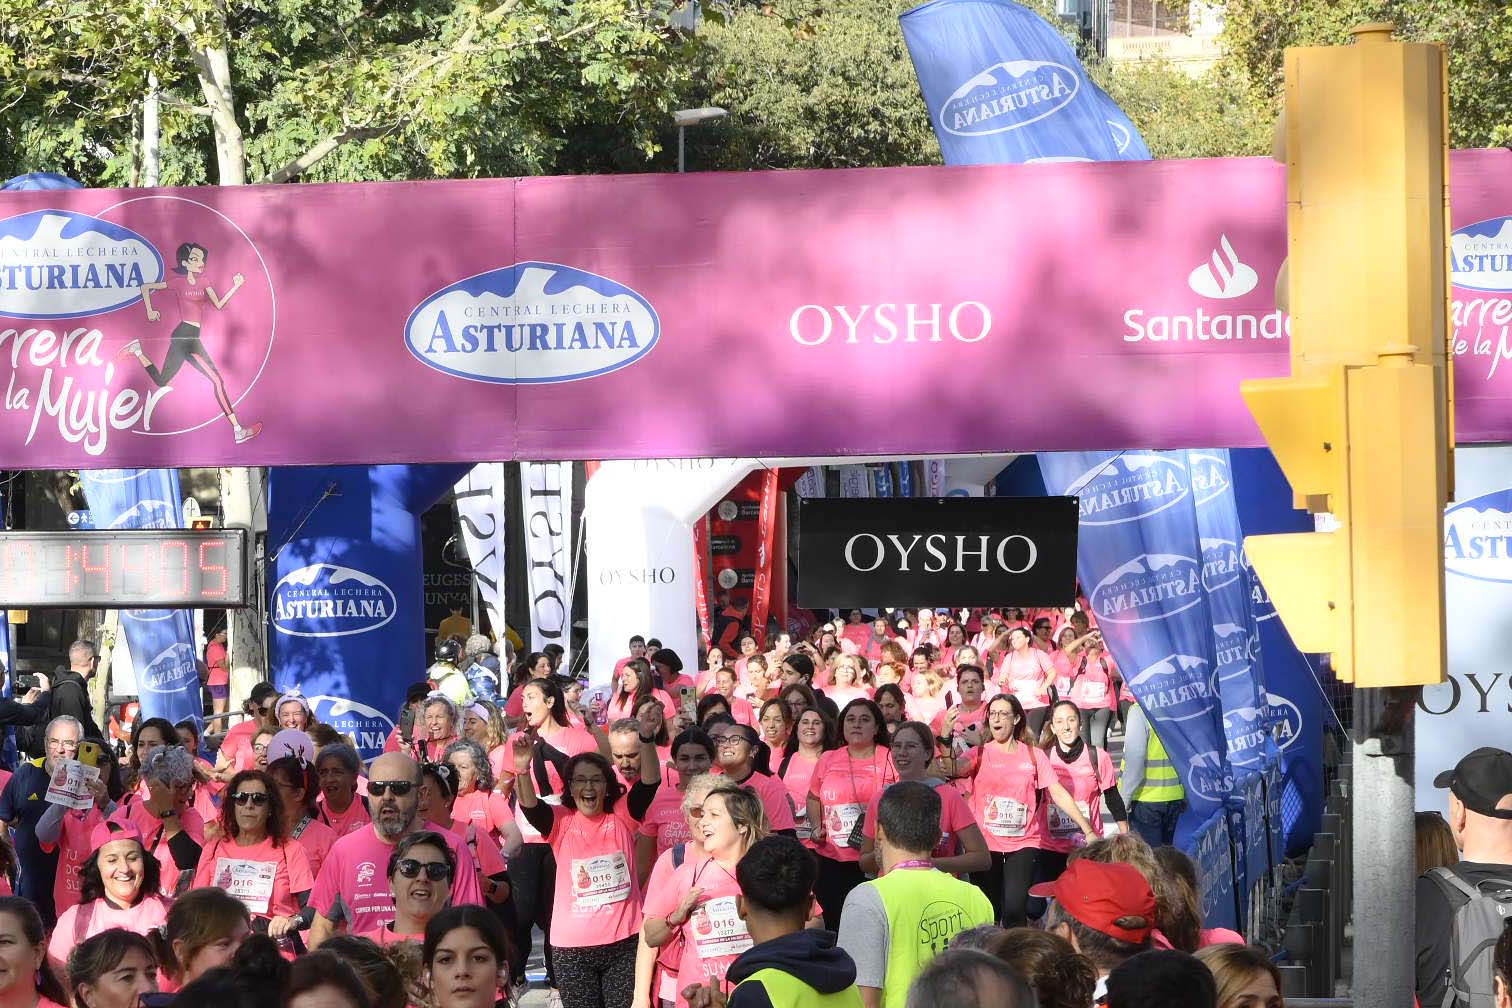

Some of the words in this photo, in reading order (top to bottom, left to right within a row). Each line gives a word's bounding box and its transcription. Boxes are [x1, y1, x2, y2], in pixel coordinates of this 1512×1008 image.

[66, 246, 139, 257] LECHERA
[464, 305, 542, 317] CENTRAL
[551, 303, 631, 315] LECHERA
[424, 309, 640, 353] ASTURIANA
[789, 301, 992, 345] OYSHO
[5, 369, 30, 410] la
[25, 362, 175, 456] Mujer
[844, 532, 1038, 574] OYSHO
[600, 566, 675, 585] OYSHO
[287, 588, 331, 598] CENTRAL
[334, 588, 383, 597] LECHERA
[275, 594, 388, 621] ASTURIANA
[334, 719, 384, 729] LECHERA
[233, 879, 254, 887] 016
[592, 873, 612, 883] 016
[713, 918, 735, 929] 016
[920, 910, 964, 945] Sport
[703, 960, 729, 977] SUM
